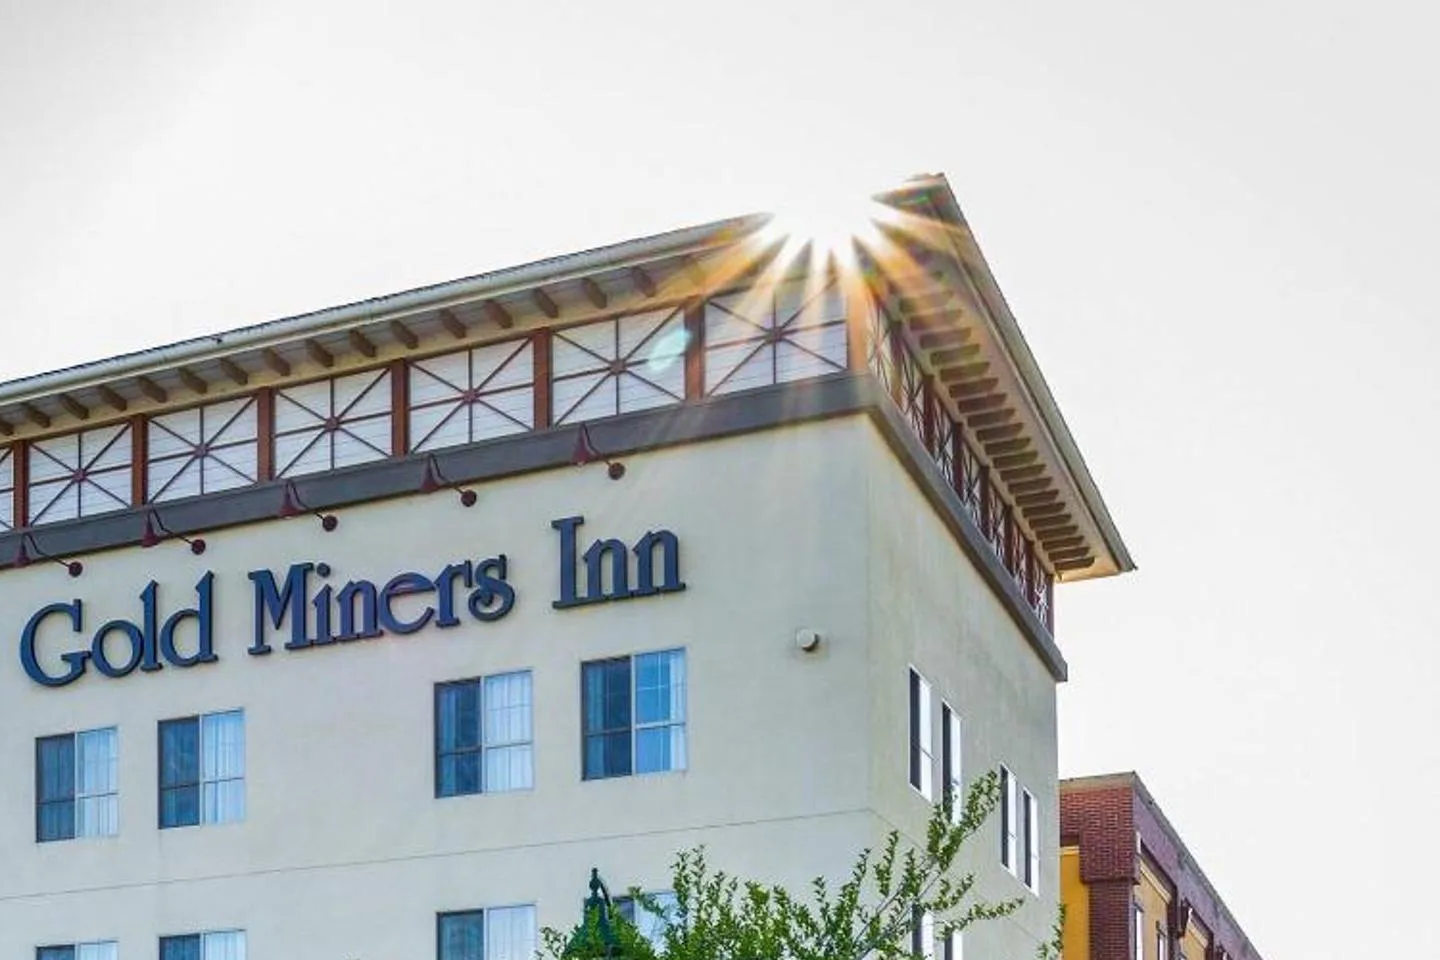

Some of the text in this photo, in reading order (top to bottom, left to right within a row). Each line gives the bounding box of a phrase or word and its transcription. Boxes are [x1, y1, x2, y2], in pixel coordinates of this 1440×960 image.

[19, 515, 688, 689] Gold Miners Inn
